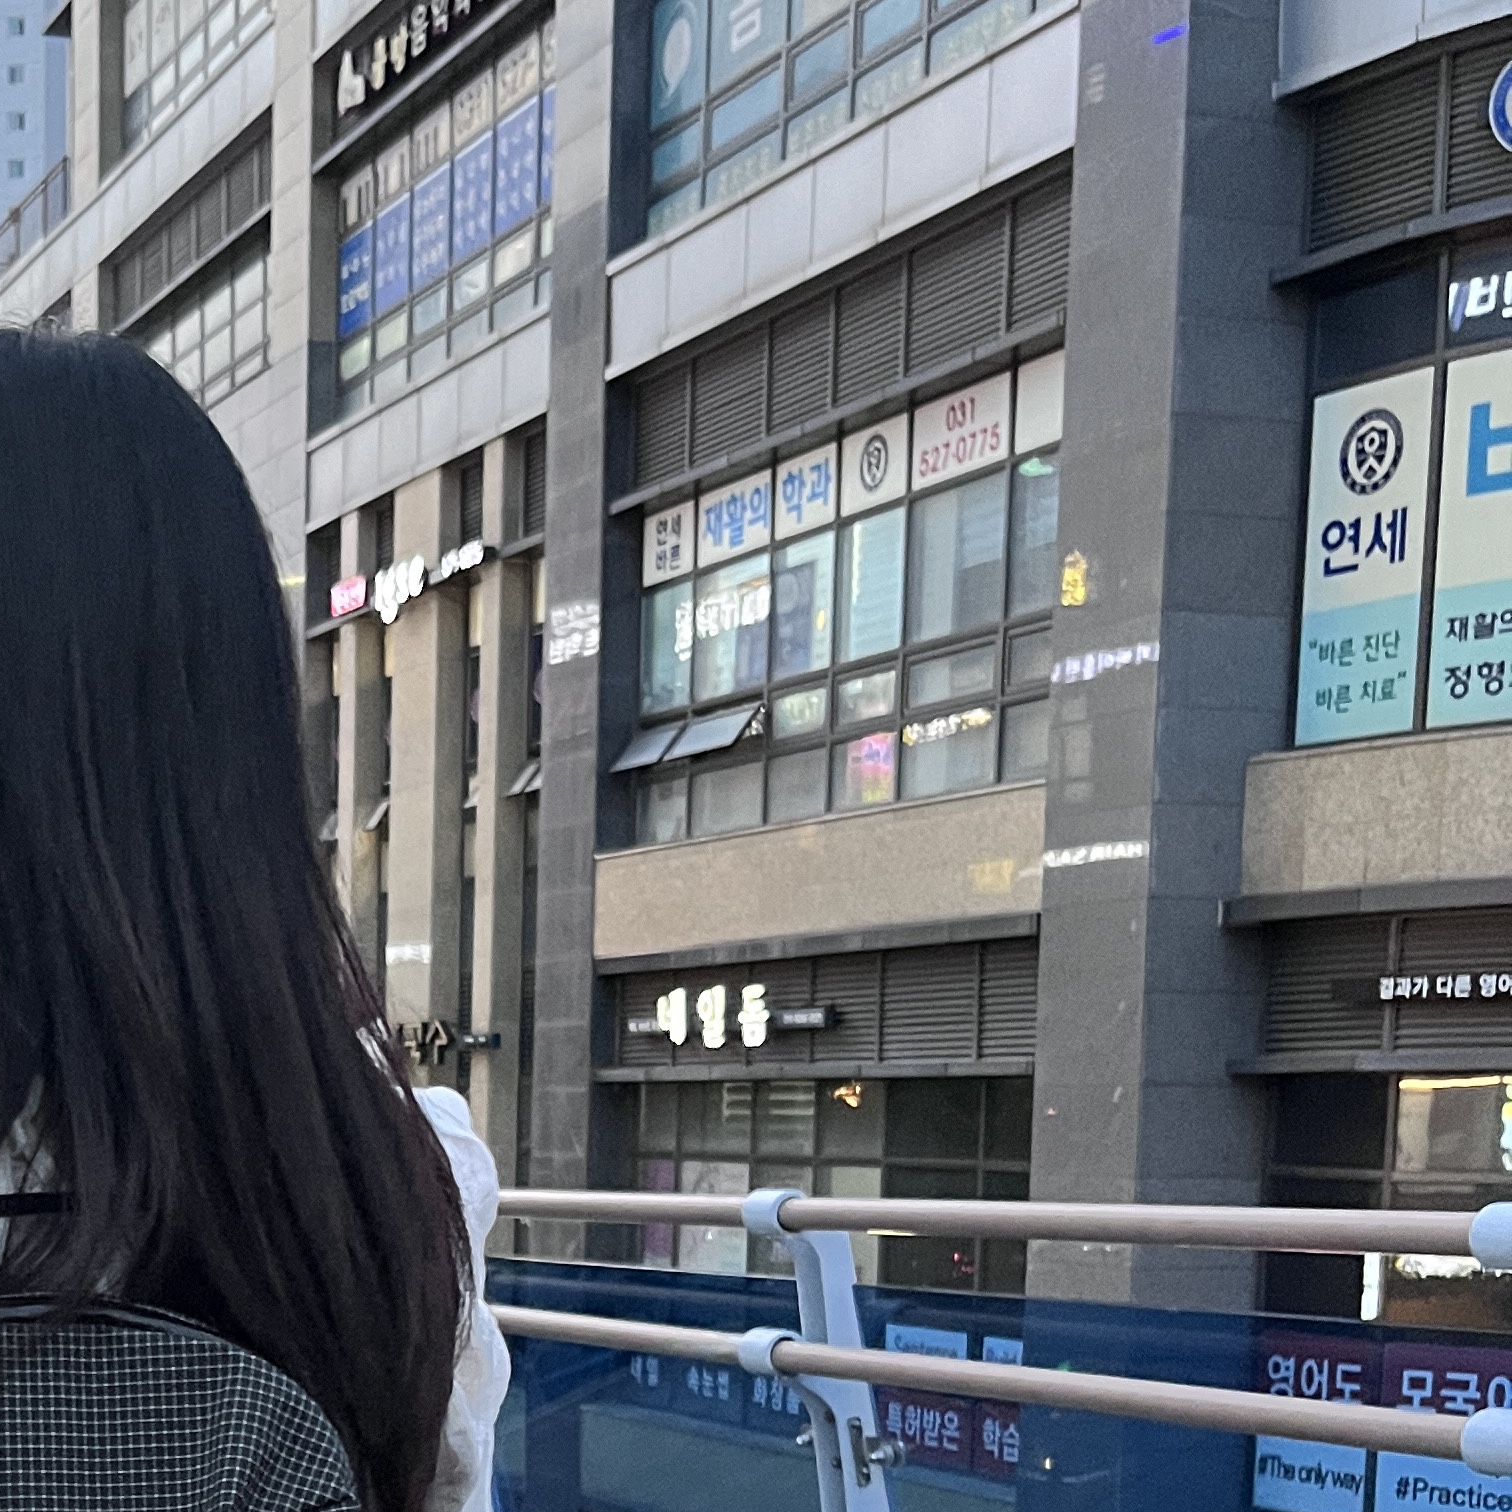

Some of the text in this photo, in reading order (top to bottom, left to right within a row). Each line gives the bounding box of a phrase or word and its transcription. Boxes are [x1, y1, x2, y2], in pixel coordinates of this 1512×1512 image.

[946, 397, 976, 431] 031
[919, 422, 1000, 477] 527-0775
[1321, 506, 1409, 577] 연세
[1362, 630, 1400, 662] 진단
[1314, 684, 1352, 713] 바른
[1436, 974, 1472, 998] 다른
[1267, 1354, 1364, 1405] 영어도
[886, 1400, 1020, 1463] 특허받은 학습
